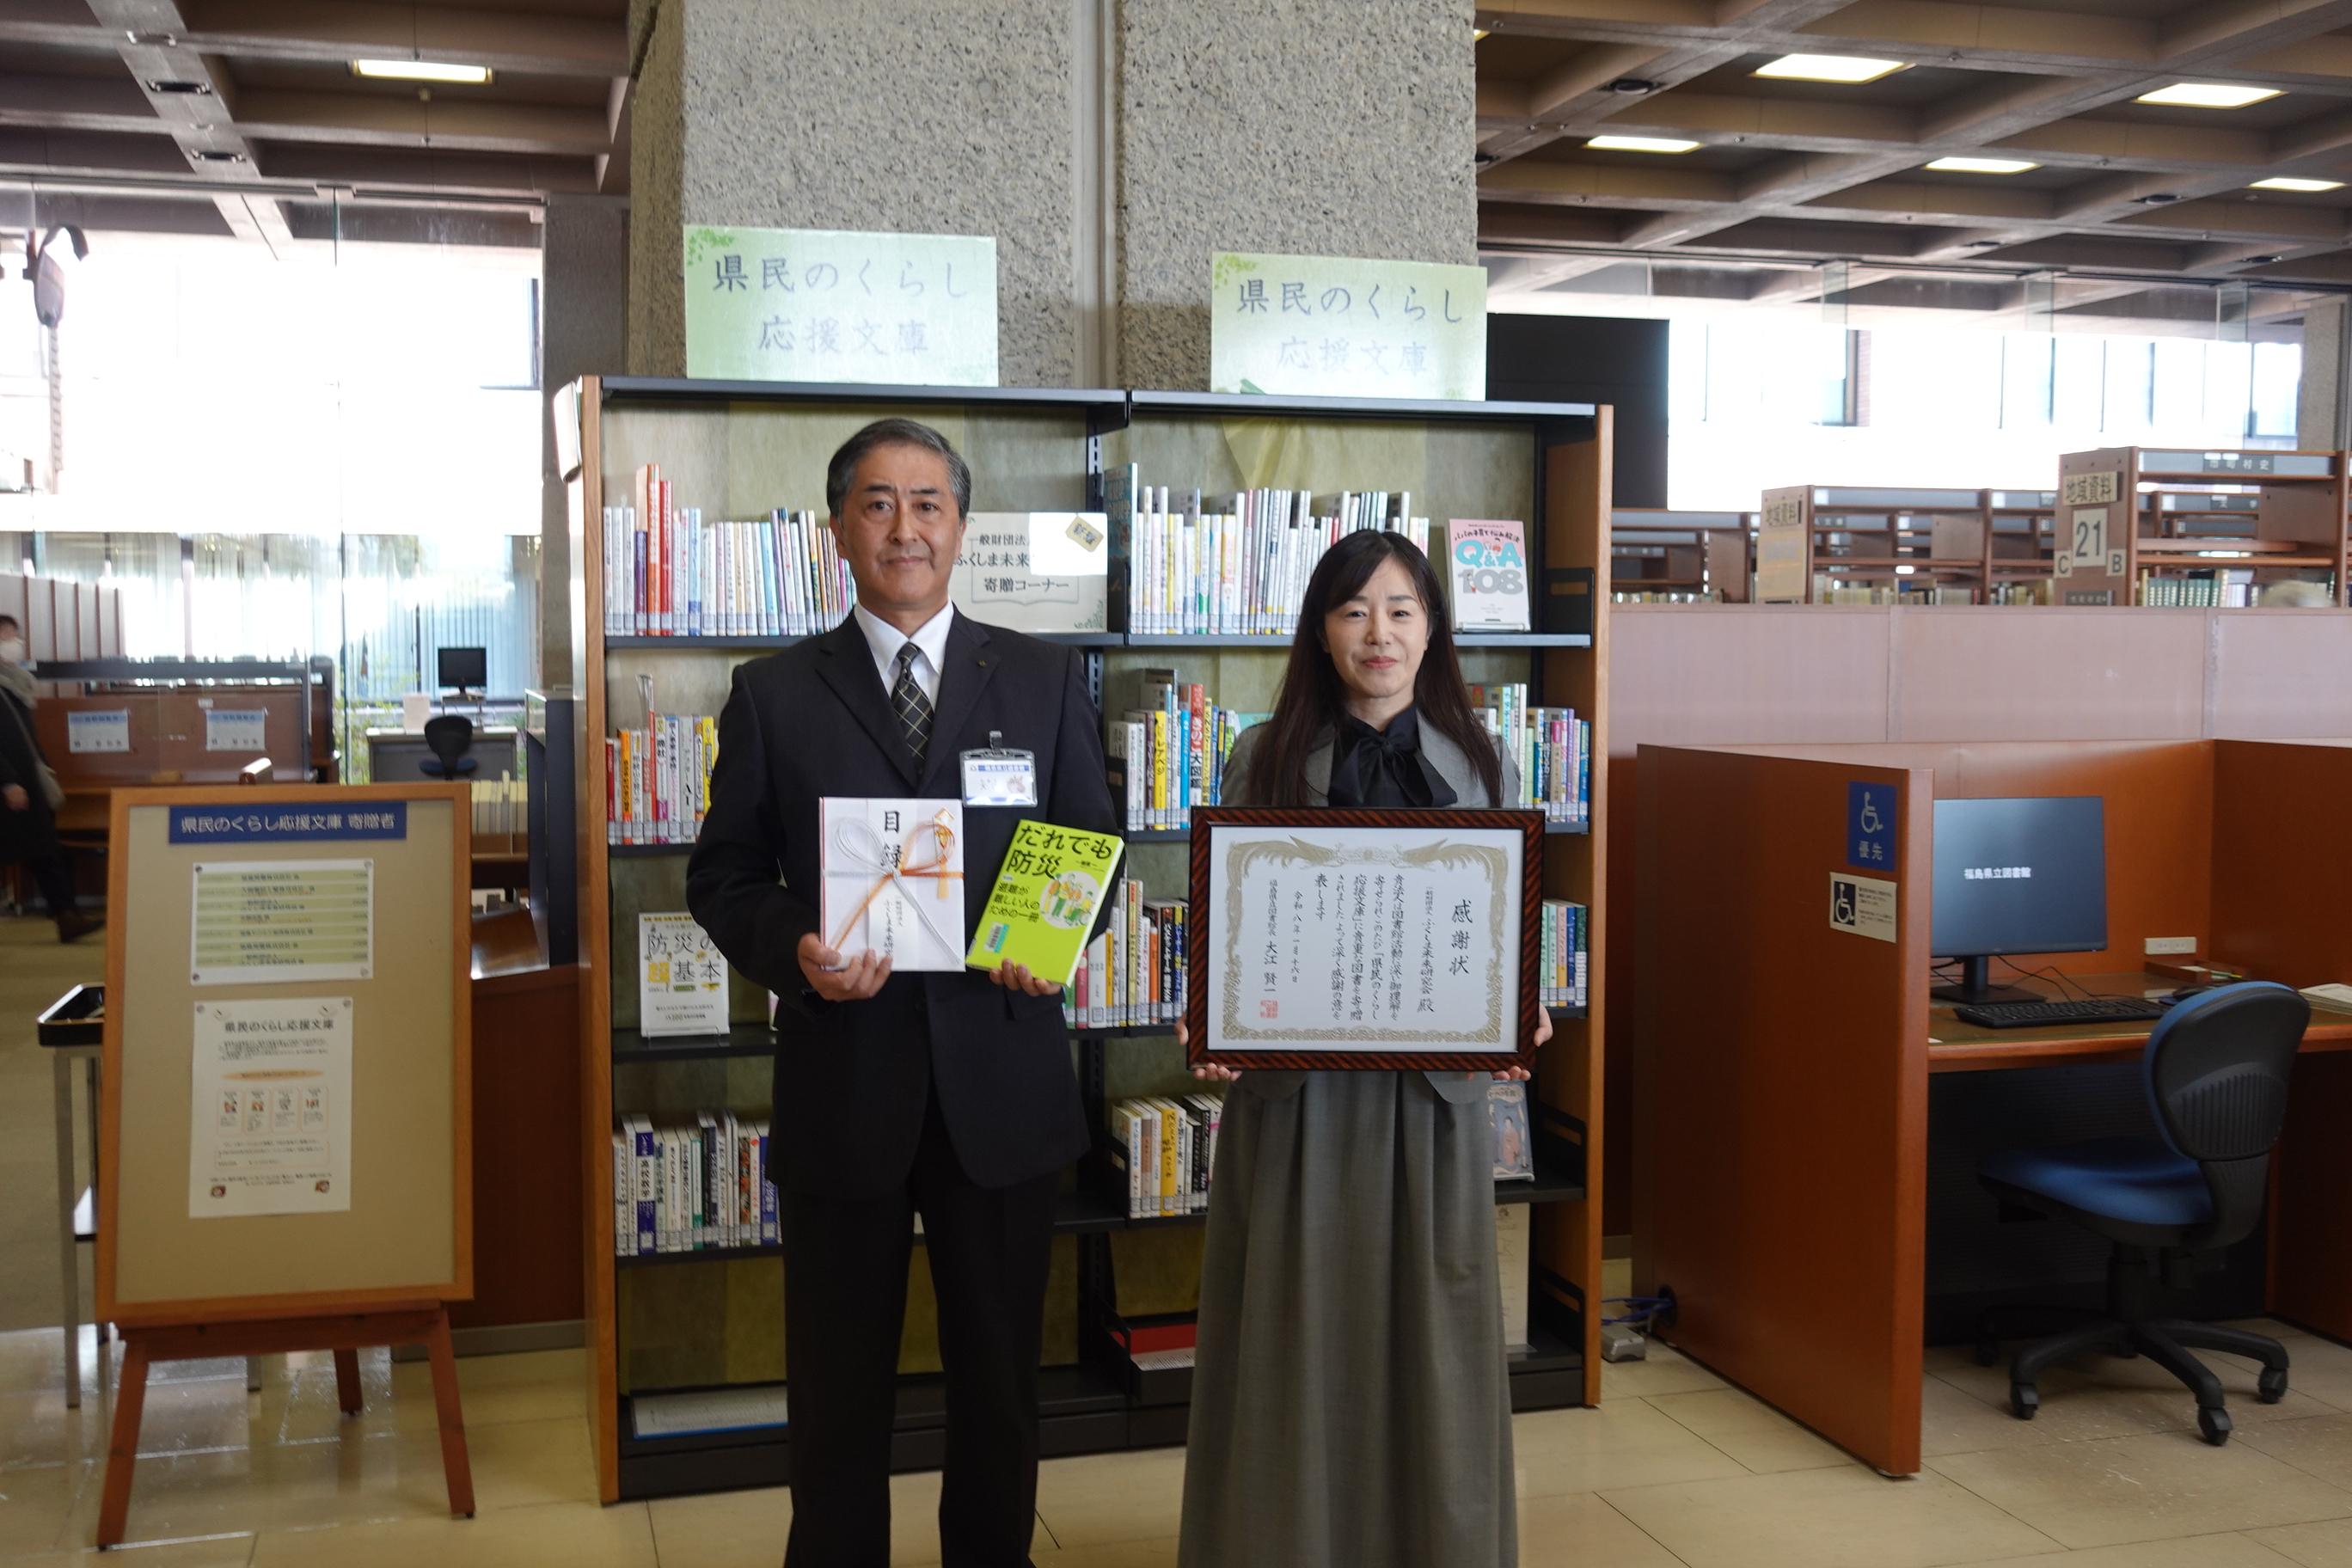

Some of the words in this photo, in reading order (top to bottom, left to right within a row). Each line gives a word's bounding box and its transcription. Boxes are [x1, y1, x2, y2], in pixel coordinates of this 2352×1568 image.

[714, 254, 967, 297] 県民のくらし
[1237, 279, 1462, 322] 県民のくらし
[758, 315, 929, 356] 応援文庫
[1277, 336, 1427, 376] 応援文庫
[968, 534, 1030, 547] 一般財団法
[2075, 520, 2101, 557] 21
[1455, 539, 1522, 568] Q&A
[2058, 555, 2069, 574] C
[2112, 554, 2122, 573] B
[983, 578, 1069, 593] 寄贈コーナー
[1457, 568, 1524, 595] 108
[181, 814, 342, 833] 県民のくらし応援文庫
[347, 812, 395, 830] 寄贈者
[1017, 825, 1112, 859] だれでも
[1859, 840, 1883, 861] 優先
[1005, 849, 1063, 880] 防災
[1964, 867, 2031, 880] 福島県立図書館
[990, 905, 1039, 922] ための一冊
[995, 894, 1040, 910] 難しい人の
[1449, 898, 1473, 976] 感謝状
[674, 959, 721, 982] 基本
